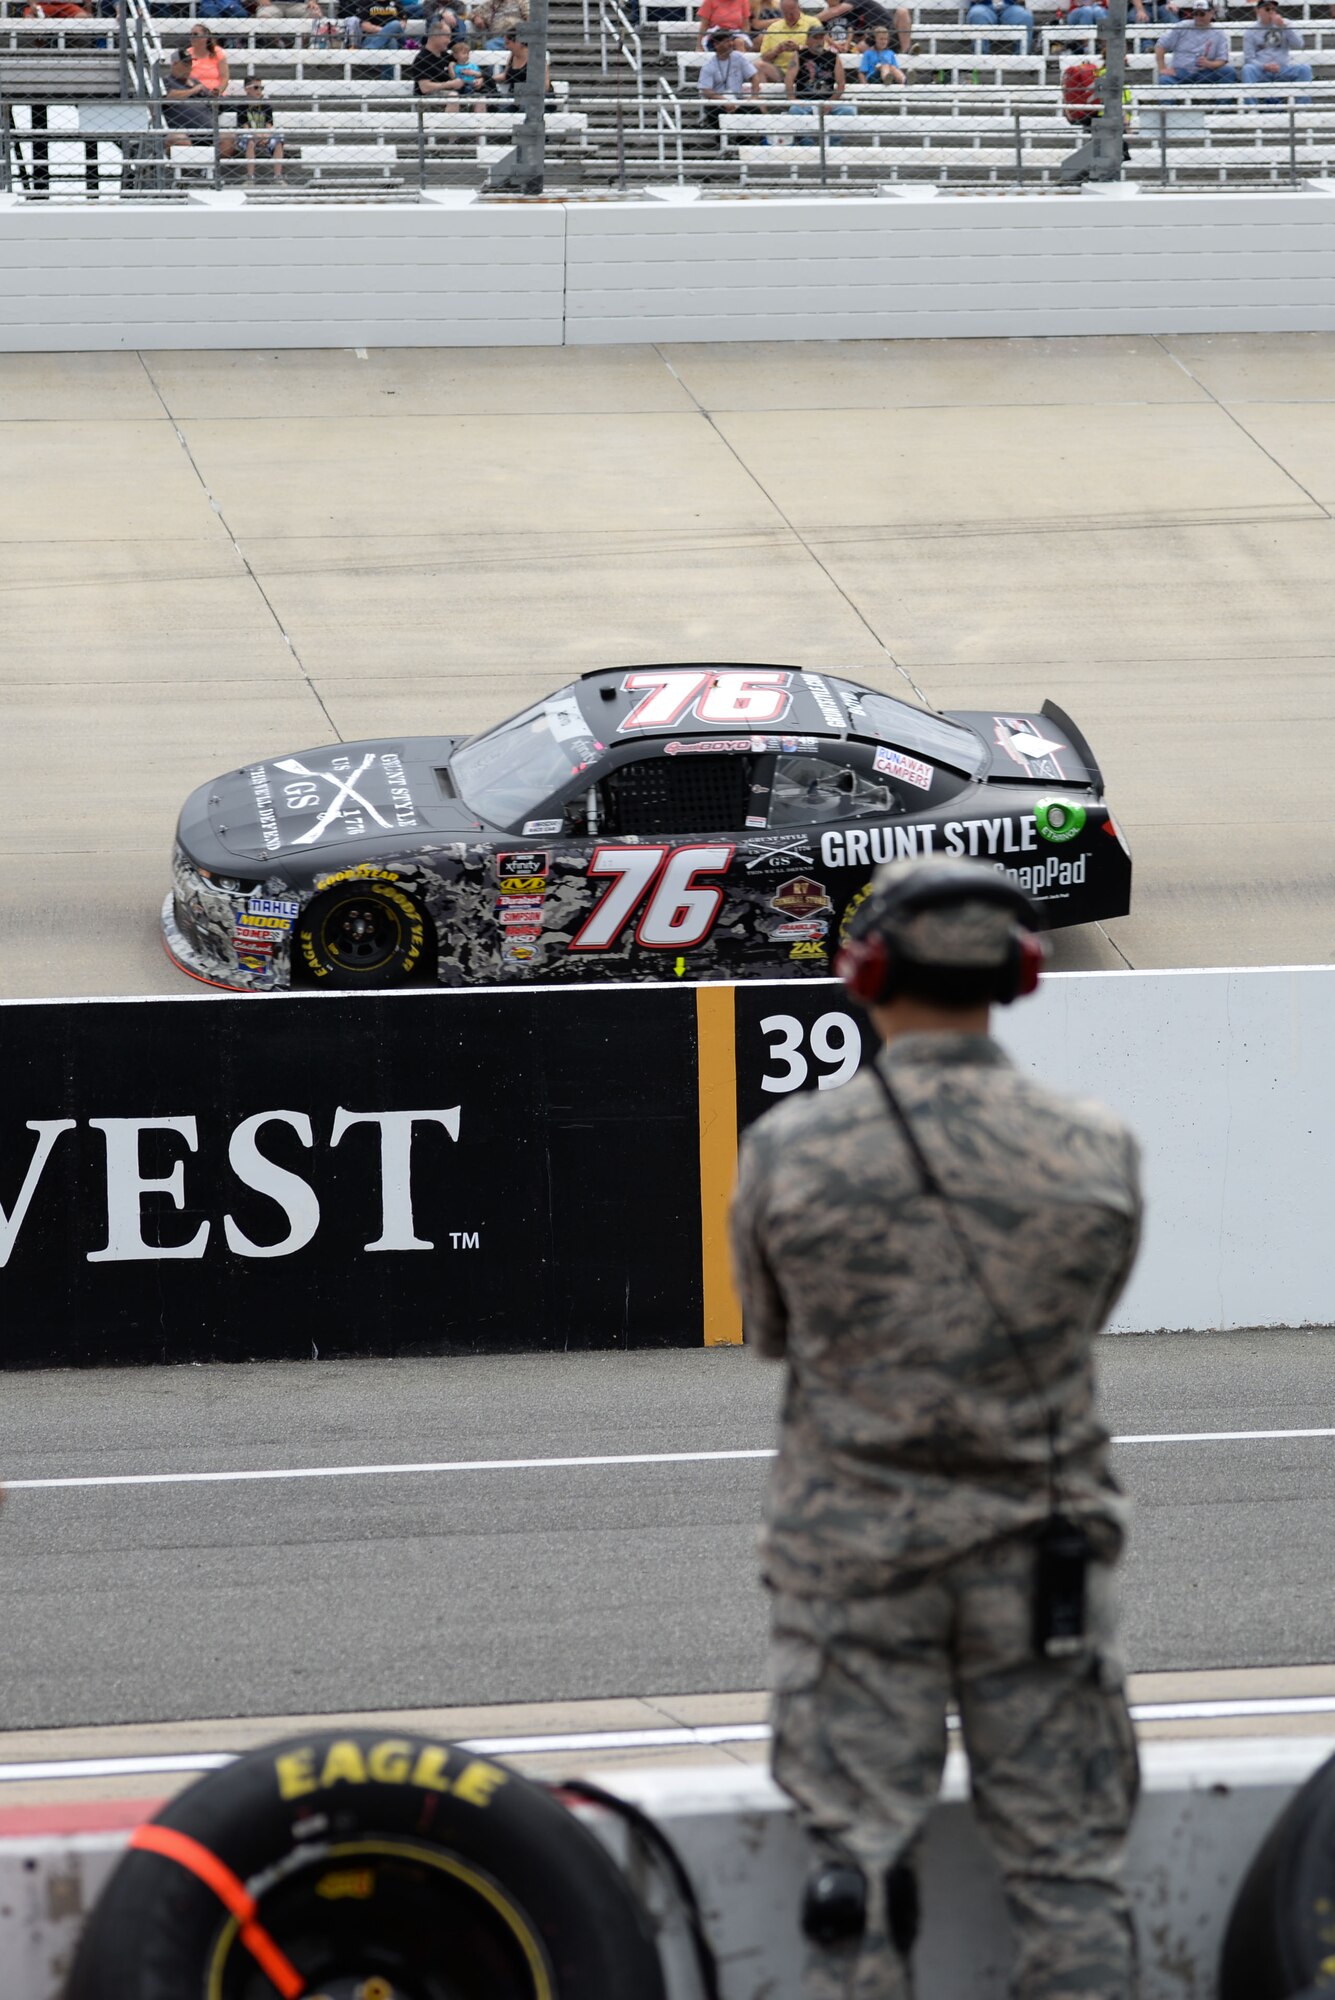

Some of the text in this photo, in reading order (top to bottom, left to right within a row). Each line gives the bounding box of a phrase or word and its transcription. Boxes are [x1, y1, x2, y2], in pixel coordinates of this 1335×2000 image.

[617, 670, 794, 733] 76
[331, 756, 351, 771] US
[877, 759, 929, 788] CAMPERS
[879, 747, 932, 776] RUNAWAY
[283, 781, 320, 809] GS
[380, 753, 417, 827] GRUNT STYLE
[258, 808, 281, 851] DEFEND
[342, 809, 366, 835] 1776
[821, 815, 1039, 868] GRUNT STYLE
[505, 860, 541, 872] xfinity
[768, 856, 791, 867] GS
[568, 843, 737, 950] 76
[792, 882, 810, 894] RV
[251, 900, 297, 915] MAHLE
[503, 911, 541, 922] SIMPSON
[235, 928, 270, 939] COMP
[239, 914, 292, 930] MOOG
[371, 883, 424, 972] GOODYEAR
[300, 930, 329, 977] EAGLE
[504, 935, 536, 944] MSD
[790, 941, 828, 954] ZAK
[761, 1011, 862, 1093] 39
[275, 1740, 509, 1807] EAGLE
